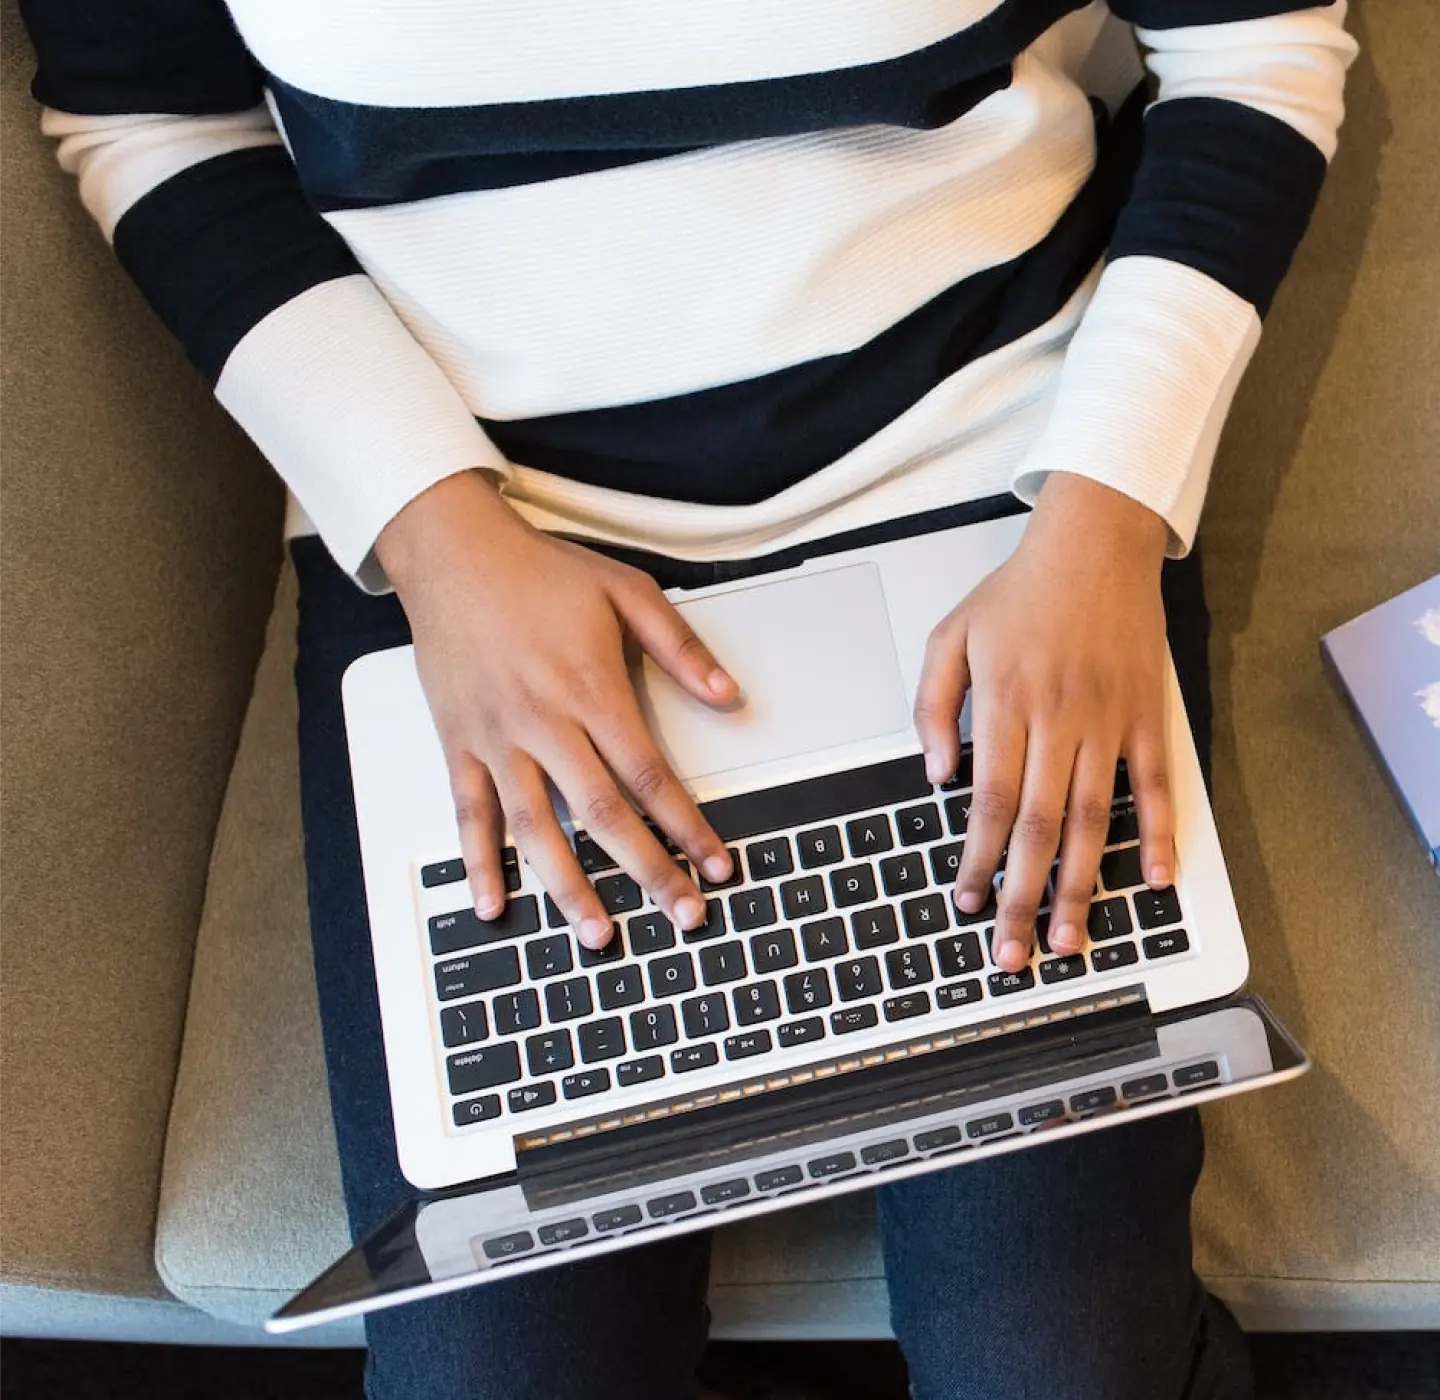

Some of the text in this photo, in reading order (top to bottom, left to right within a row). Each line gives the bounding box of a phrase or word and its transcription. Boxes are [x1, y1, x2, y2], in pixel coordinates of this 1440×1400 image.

[913, 817, 925, 830] C
[865, 829, 876, 842] V
[814, 839, 825, 853] B
[763, 851, 776, 864] N
[948, 855, 959, 868] D
[899, 867, 908, 880] F
[846, 878, 859, 892] G
[796, 890, 810, 904] H
[748, 901, 756, 914] J
[920, 908, 930, 921] R
[436, 917, 455, 928] shift
[871, 921, 880, 934] T
[646, 925, 656, 937] L
[819, 932, 830, 945] Y
[1158, 939, 1174, 948] esc
[768, 943, 781, 957] U
[443, 961, 469, 973] return
[665, 968, 678, 981] O
[615, 979, 625, 993] P
[455, 1054, 482, 1066] delete
